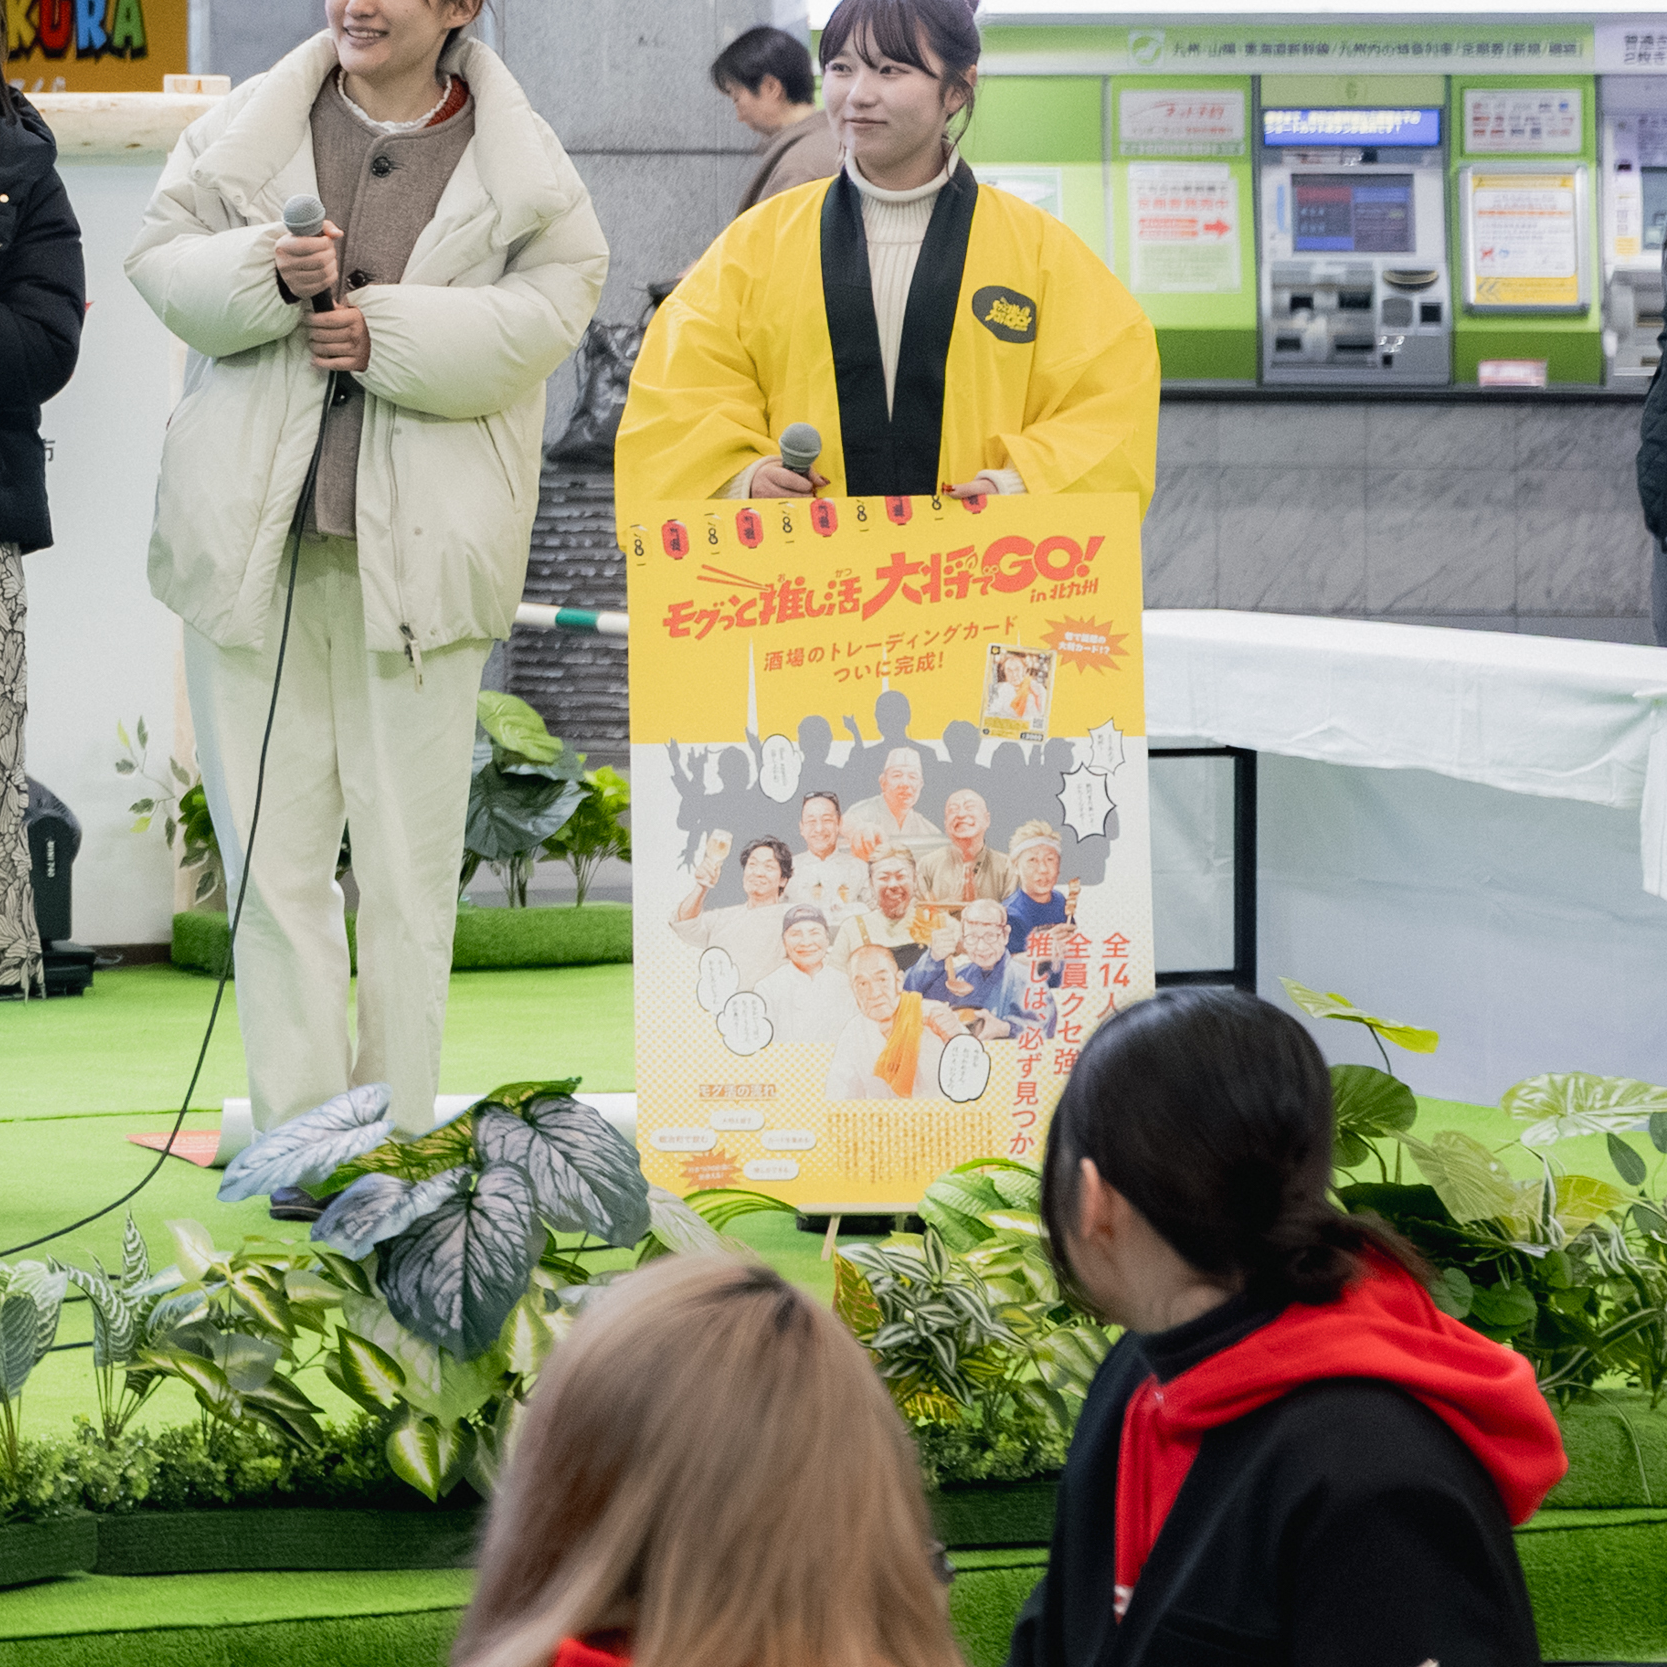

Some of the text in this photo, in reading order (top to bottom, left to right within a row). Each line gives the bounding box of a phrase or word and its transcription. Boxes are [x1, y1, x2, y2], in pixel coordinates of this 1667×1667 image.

[1030, 575, 1100, 604] in 北九州
[763, 615, 1018, 672] 酒場のトレーディングカード
[832, 651, 945, 684] ついに完成!
[1008, 932, 1054, 1156] 推しは、必ず見つか
